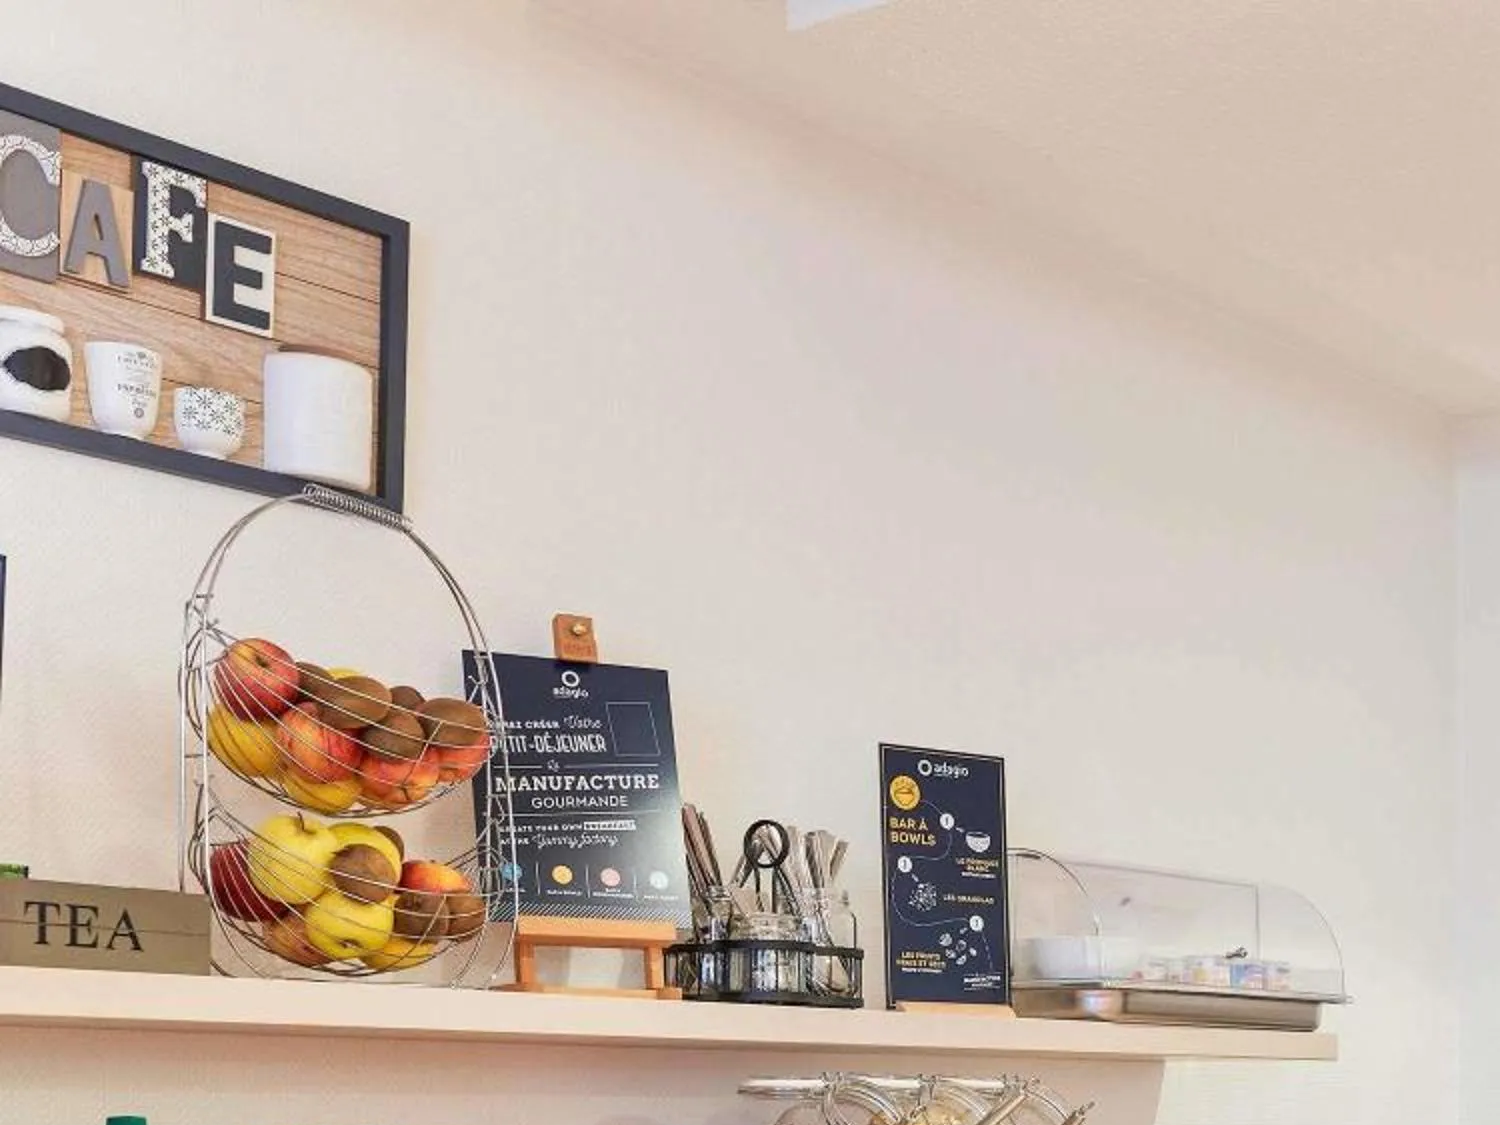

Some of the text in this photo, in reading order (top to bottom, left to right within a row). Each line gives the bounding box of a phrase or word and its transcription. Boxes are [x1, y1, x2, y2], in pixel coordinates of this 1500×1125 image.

[0, 134, 272, 331] CAFE
[495, 774, 660, 792] MANUFACTURE
[531, 795, 629, 809] GOURMANDE
[890, 817, 917, 831] BAR
[891, 832, 937, 846] BOWLS
[24, 901, 144, 953] TEA
